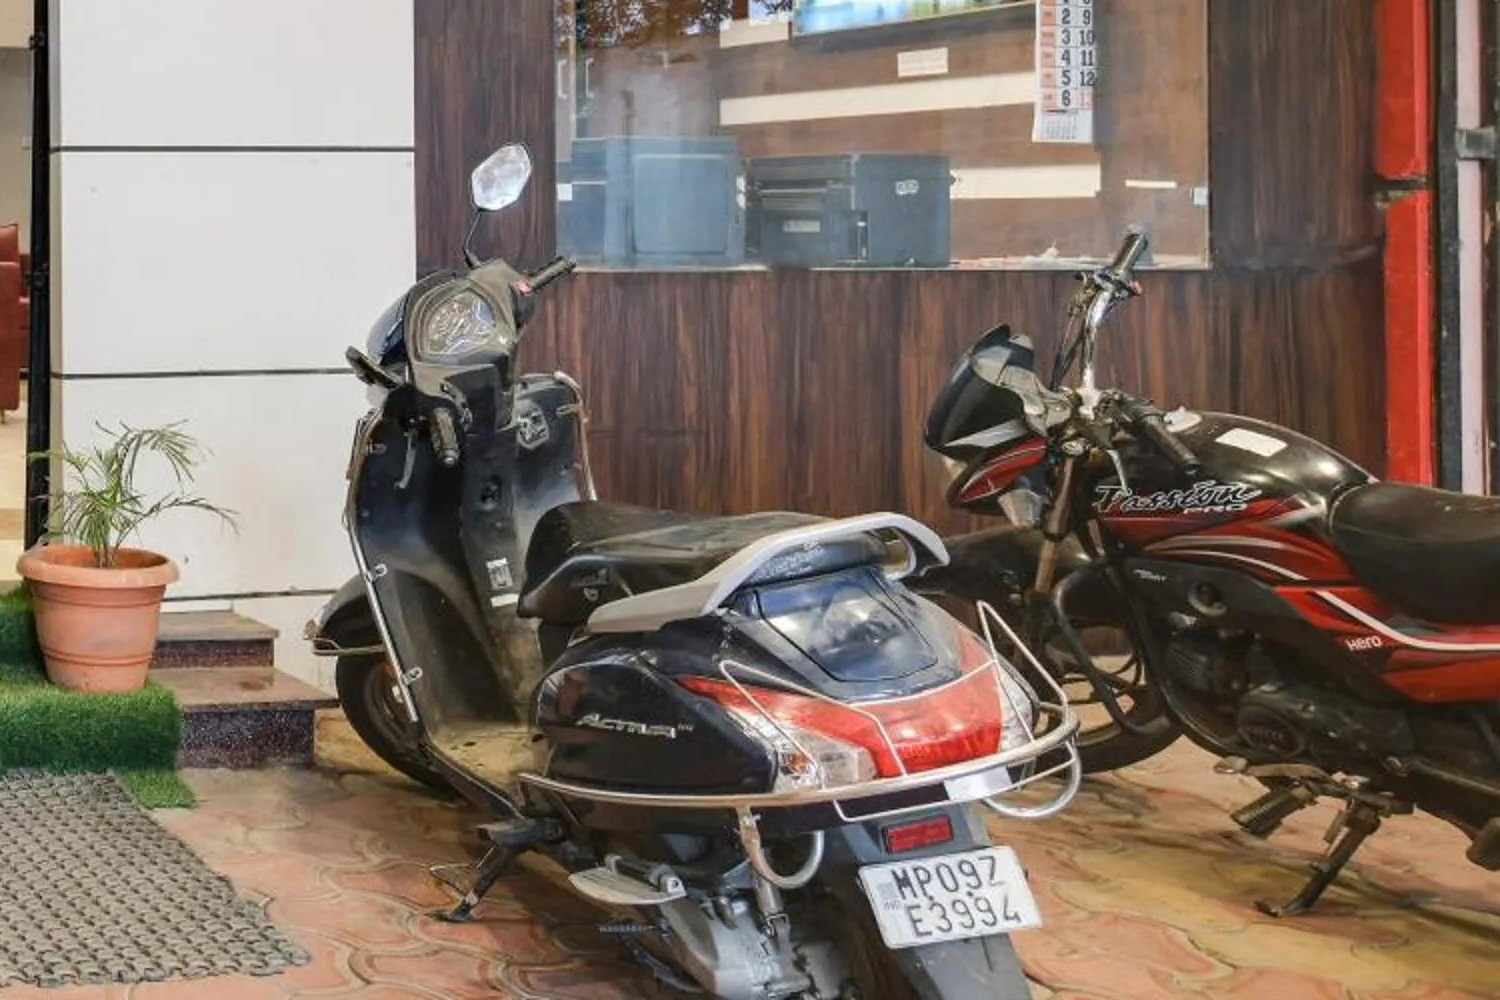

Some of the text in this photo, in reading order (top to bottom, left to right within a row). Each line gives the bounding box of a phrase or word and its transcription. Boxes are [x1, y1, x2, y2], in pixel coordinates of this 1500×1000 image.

[1062, 8, 1091, 26] 2 9
[1061, 29, 1094, 47] 3 10
[1061, 49, 1093, 67] 4 11
[1061, 69, 1095, 87] 5 12
[1061, 89, 1071, 107] 6
[906, 893, 1021, 938] E3994
